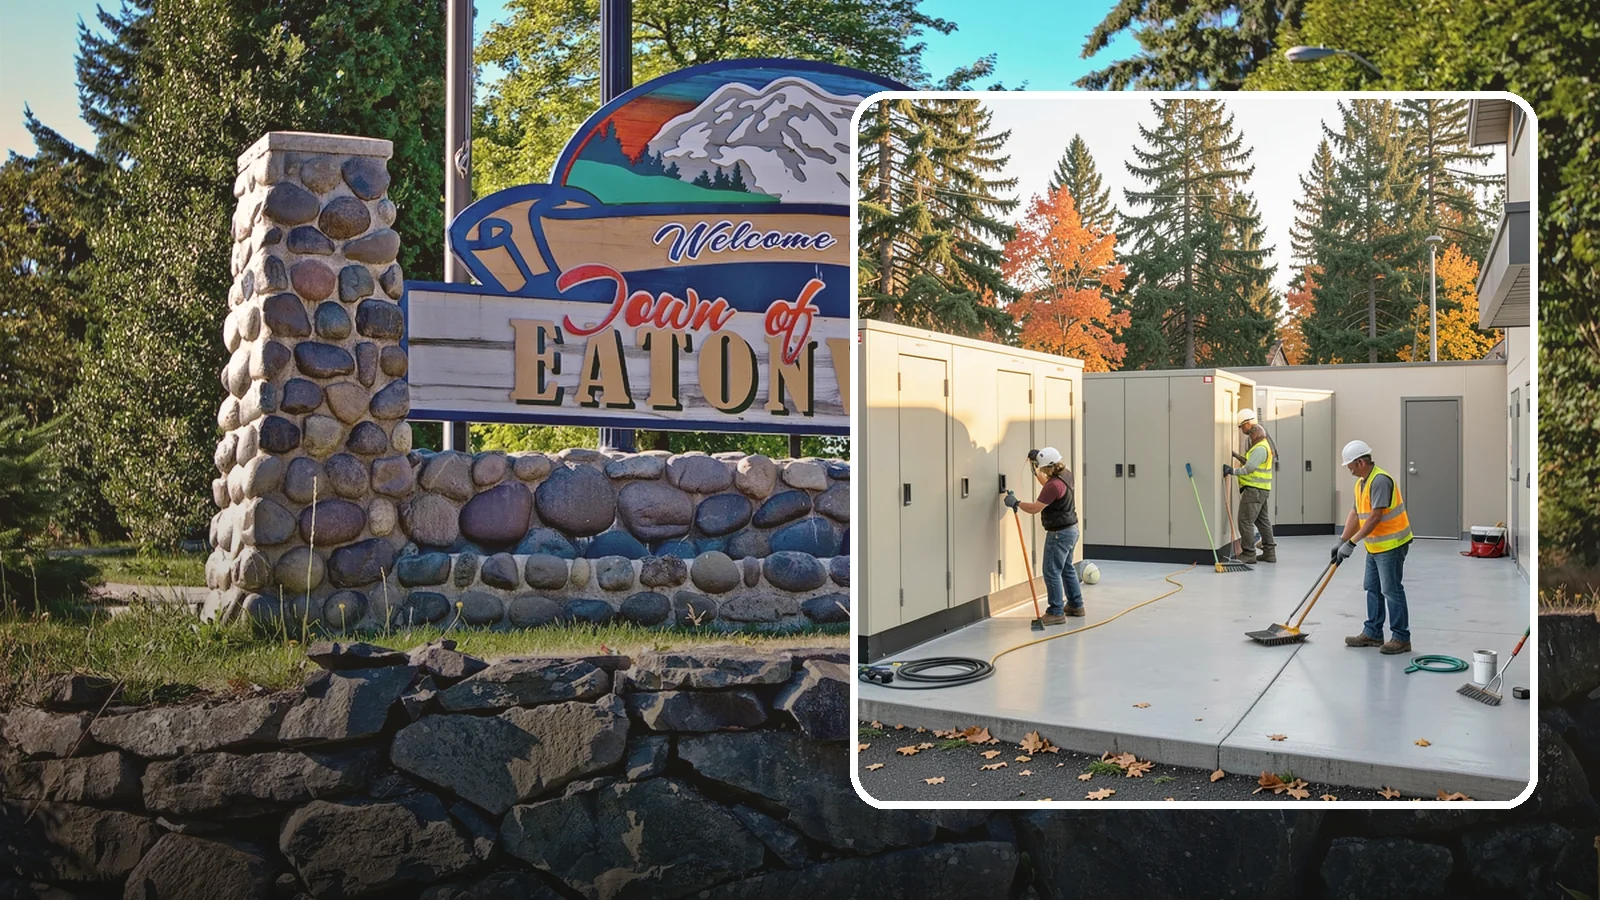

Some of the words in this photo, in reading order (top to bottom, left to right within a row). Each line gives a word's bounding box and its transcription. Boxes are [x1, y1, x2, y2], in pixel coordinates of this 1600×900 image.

[653, 220, 837, 263] Welcome
[556, 263, 737, 336] Town
[765, 278, 826, 365] of
